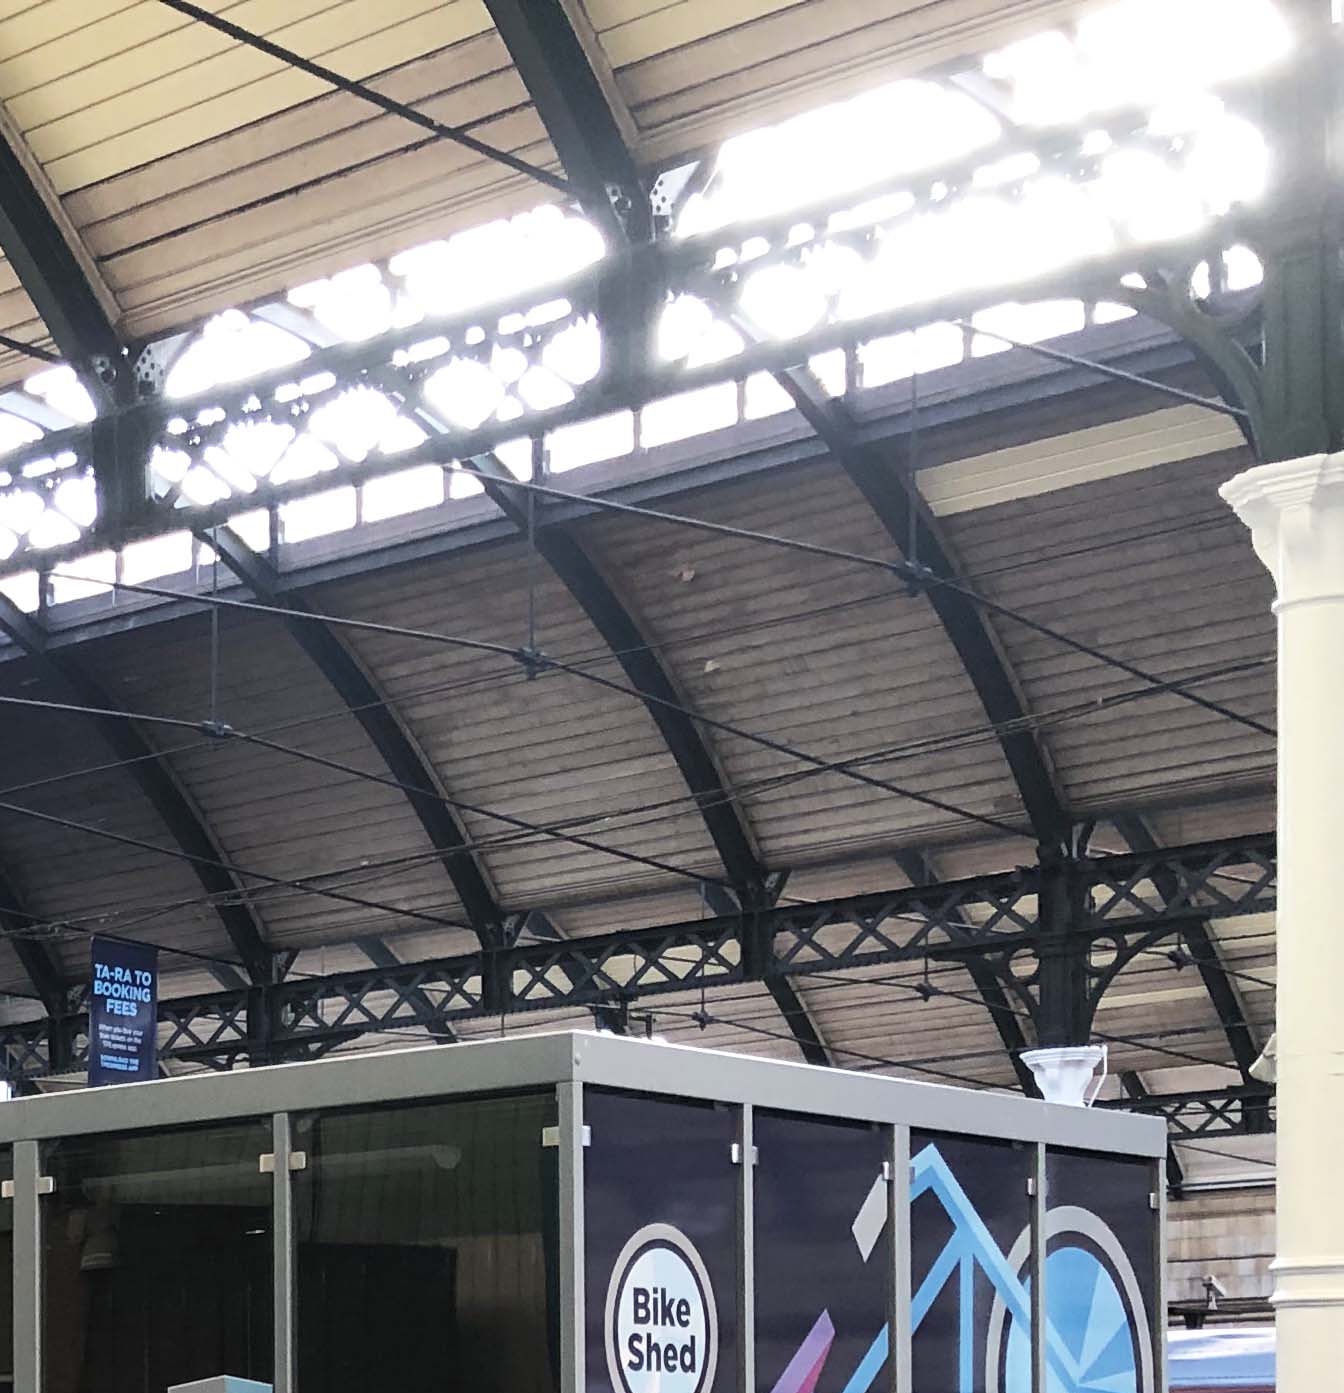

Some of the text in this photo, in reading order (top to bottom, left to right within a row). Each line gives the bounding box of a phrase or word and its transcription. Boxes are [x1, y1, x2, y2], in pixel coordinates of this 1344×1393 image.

[95, 963, 152, 986] TA-RA TO
[94, 980, 151, 1003] BOOKING
[106, 998, 138, 1017] FEES
[633, 1287, 691, 1328] Bike
[627, 1332, 696, 1374] Shed
